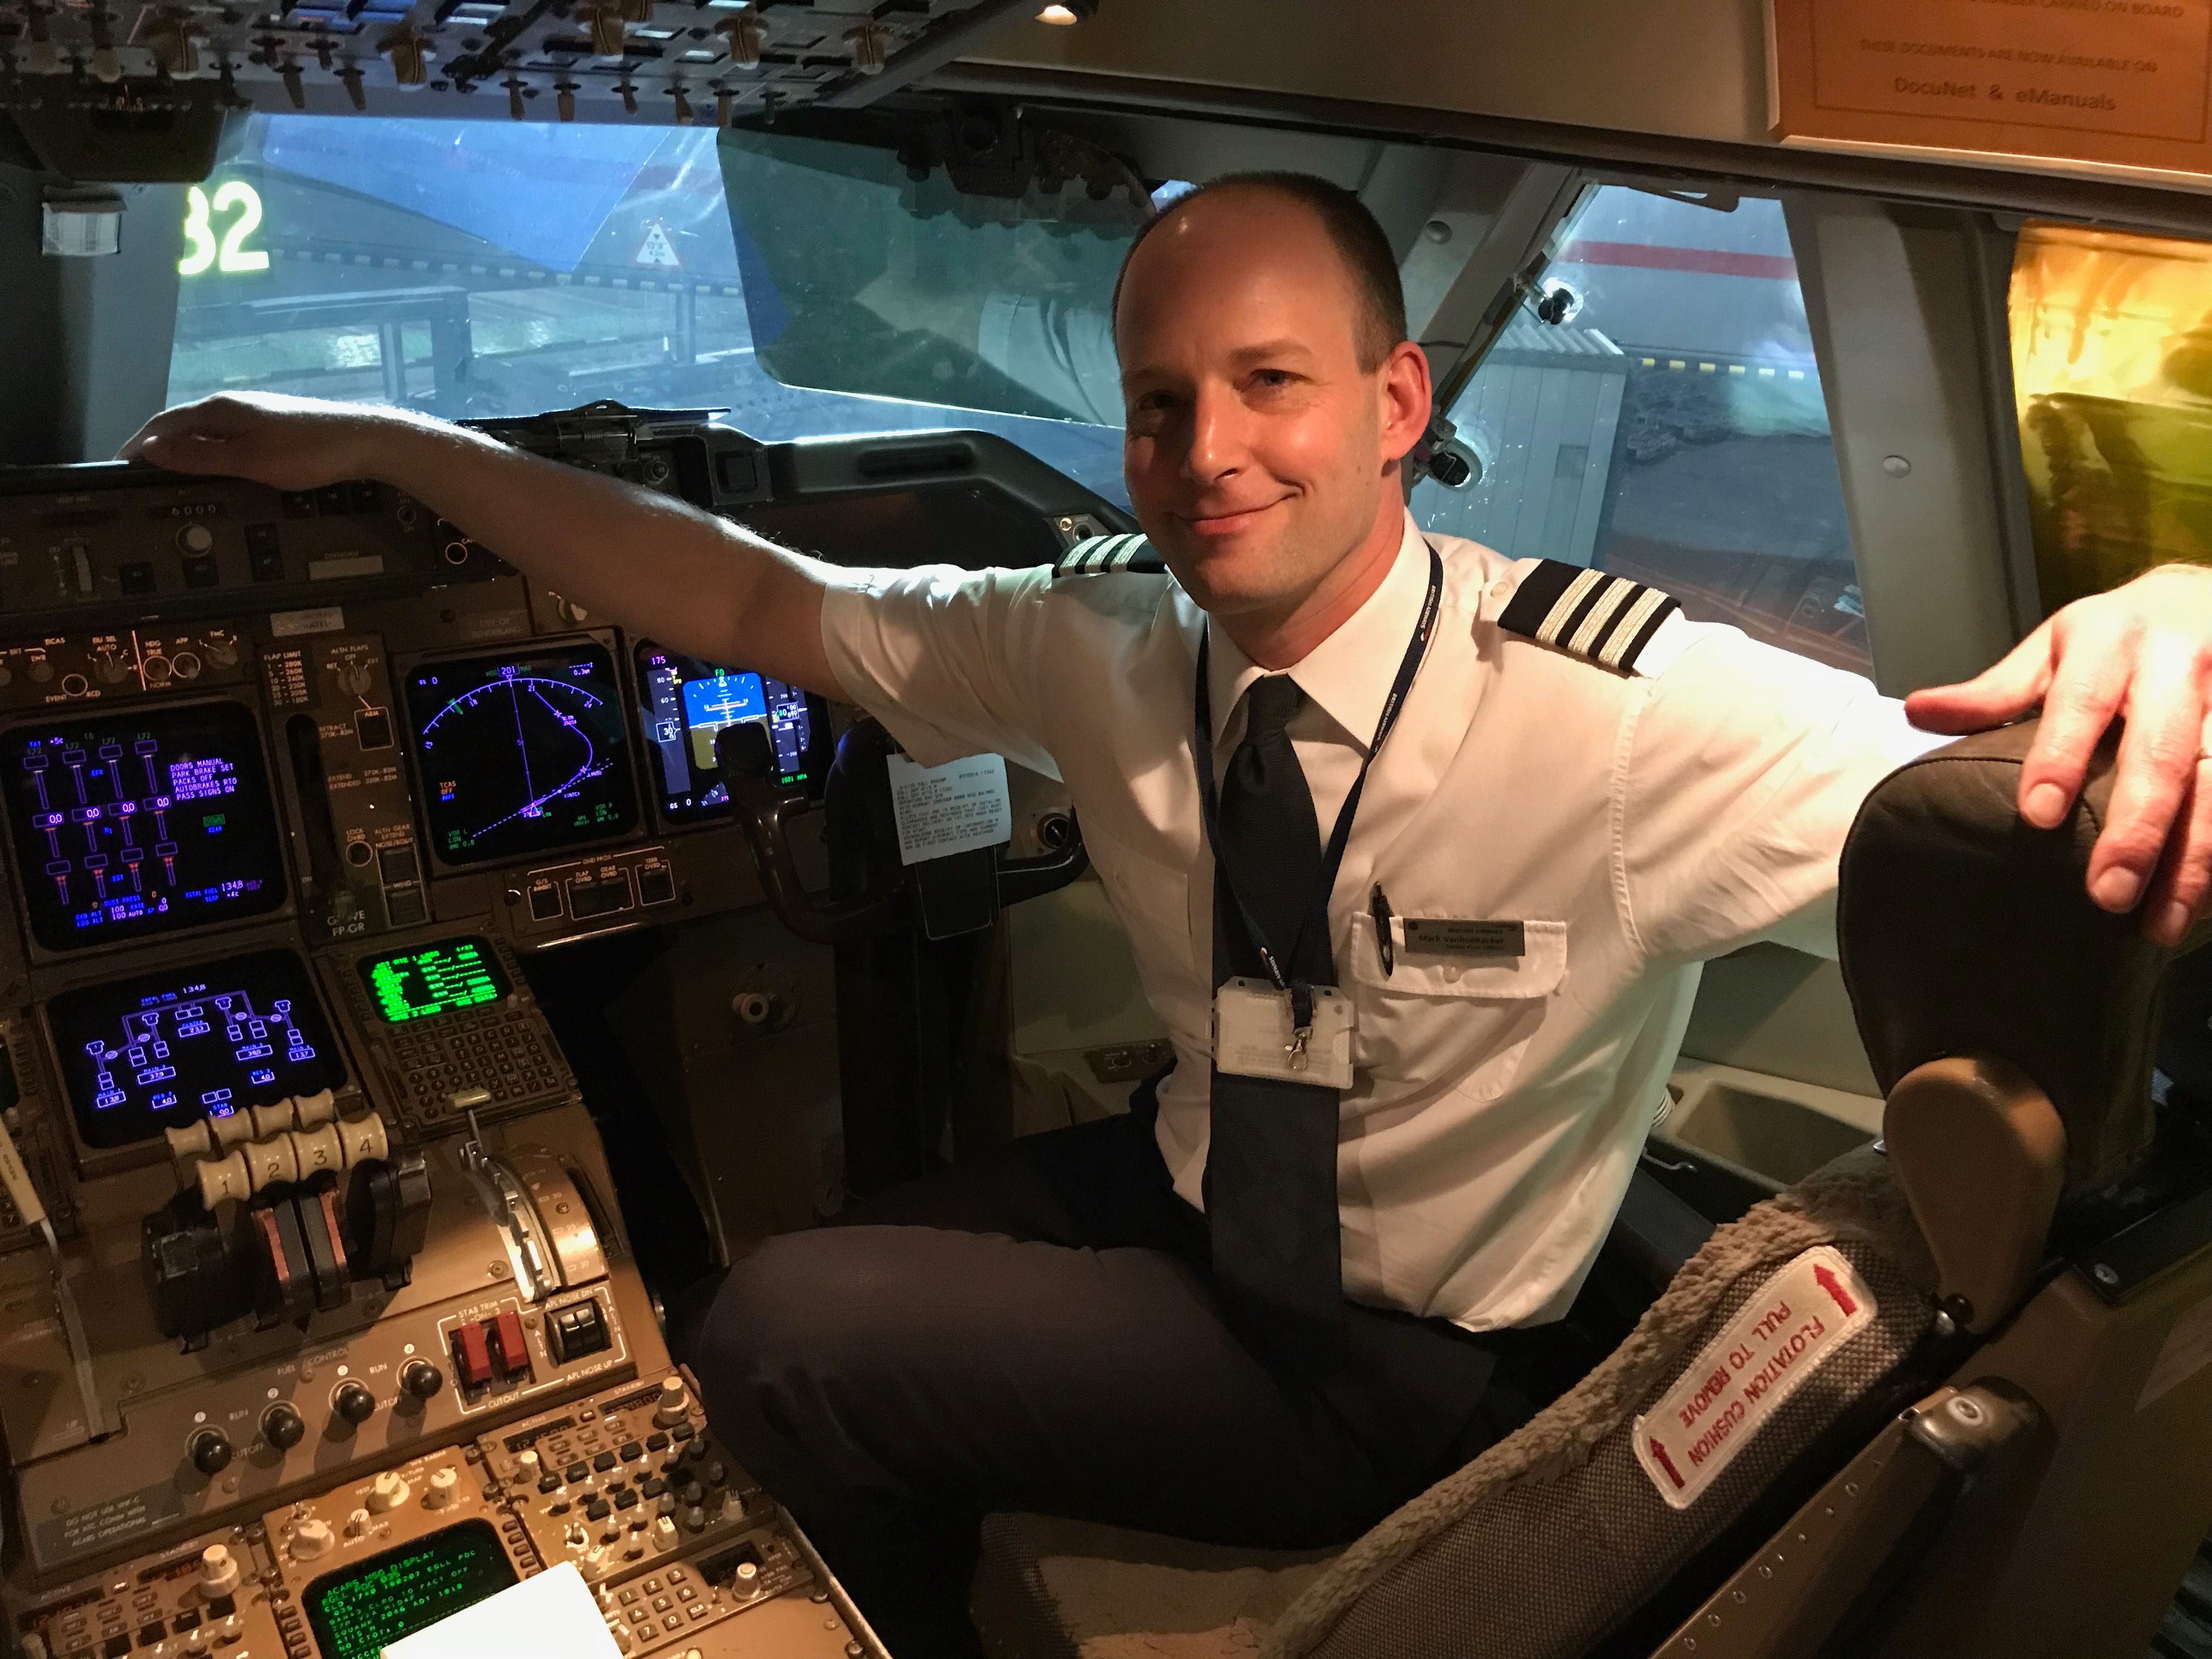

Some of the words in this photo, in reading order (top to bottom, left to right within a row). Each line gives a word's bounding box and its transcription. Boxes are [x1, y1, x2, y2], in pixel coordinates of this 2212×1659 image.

[2104, 2, 2128, 12] ON
[2132, 3, 2183, 18] BOARD
[1899, 42, 1985, 59] DOCUMENTS
[1988, 48, 2013, 61] ARE
[2017, 50, 2053, 64] NOW
[2057, 54, 2130, 71] AVAILABLE
[1894, 77, 1975, 99] DocuNet
[1988, 83, 2002, 100] &
[2015, 87, 2116, 110] eManuals
[1427, 585, 1436, 606] BRITISH
[1420, 606, 1431, 629] AIRWAYS
[283, 650, 301, 659] LIMIT
[652, 656, 666, 665] 175
[501, 665, 515, 674] 201
[715, 668, 725, 676] FD
[46, 694, 67, 702] EVENT
[1385, 693, 1398, 716] BRITISH
[319, 723, 346, 732] RETRACT
[1377, 715, 1389, 741] AIRWAYS
[170, 762, 193, 771] DOORS
[197, 758, 223, 768] MANUAL
[172, 770, 190, 778] PARK
[194, 766, 216, 775] BRAKE
[221, 763, 233, 771] SET
[173, 777, 196, 786] PACKS
[328, 773, 352, 782] EXTEND
[781, 776, 794, 784] 1021
[175, 781, 219, 793] AUTOBRAKES
[330, 780, 361, 790] EXTENDED
[440, 781, 456, 789] TCAS
[177, 792, 195, 800] PASS
[199, 788, 221, 797] SIGNS
[347, 834, 365, 842] OVRD
[381, 831, 405, 840] EXTEND
[393, 880, 412, 888] WING
[111, 905, 124, 913] 100
[112, 912, 126, 921] 100
[332, 922, 365, 936] FP-GR
[1268, 956, 1281, 979] AIRWAYS
[360, 1139, 373, 1153] 4
[314, 1150, 328, 1165] 3
[268, 1163, 281, 1178] 2
[222, 1181, 229, 1195] 1
[545, 1300, 558, 1310] APL
[560, 1292, 580, 1305] NOSE
[582, 1289, 594, 1298] DN
[458, 1306, 479, 1318] STAB
[481, 1301, 499, 1312] TRIM
[609, 1305, 621, 1332] ALTN
[1752, 1300, 1792, 1341] PULL
[534, 1330, 548, 1358] ALTN
[277, 1364, 297, 1375] FUEL
[307, 1347, 349, 1366] CONTROL
[1730, 1343, 1755, 1369] TO
[1743, 1316, 1826, 1404] FLOTATION
[369, 1363, 388, 1374] RUN
[567, 1372, 580, 1381] APL
[582, 1363, 603, 1376] NOSE
[605, 1359, 613, 1369] UP
[614, 1380, 644, 1395] STANDBY
[488, 1392, 520, 1409] CUTOUT
[1679, 1365, 1731, 1428] REMOVE
[229, 1408, 249, 1421] RUN
[522, 1415, 546, 1427] ACTIVE
[1688, 1400, 1746, 1466] CUSHION
[232, 1442, 264, 1459] CUTOFF
[424, 1451, 447, 1462] RADAR
[356, 1485, 370, 1495] TEST
[64, 1528, 80, 1538] FOR
[99, 1513, 125, 1526] COMM
[127, 1505, 145, 1516] WITH
[66, 1517, 78, 1527] DO
[82, 1510, 98, 1521] NOT
[100, 1505, 114, 1515] USE
[98, 1516, 146, 1537] OPERATIONAL
[373, 1521, 389, 1531] MAX
[343, 1536, 365, 1548] AUTO
[160, 1541, 198, 1559] STANDBY
[328, 1579, 359, 1595] ACARS
[365, 1569, 385, 1581] MSG
[390, 1550, 434, 1572] DISPLAY
[451, 1566, 468, 1577] OFF
[673, 1570, 681, 1578] 3
[325, 1601, 343, 1612] CLD
[427, 1560, 452, 1572] EGLL
[458, 1550, 476, 1560] PDC
[650, 1581, 657, 1589] 2
[322, 1592, 348, 1606] EGLL
[354, 1581, 375, 1592] PDC
[690, 1603, 704, 1613] CLR
[669, 1615, 676, 1623] 0
[334, 1620, 373, 1639] SQUAWK
[644, 1626, 650, 1634] 7
[337, 1630, 363, 1644] ATIS
[338, 1643, 352, 1651] NO
